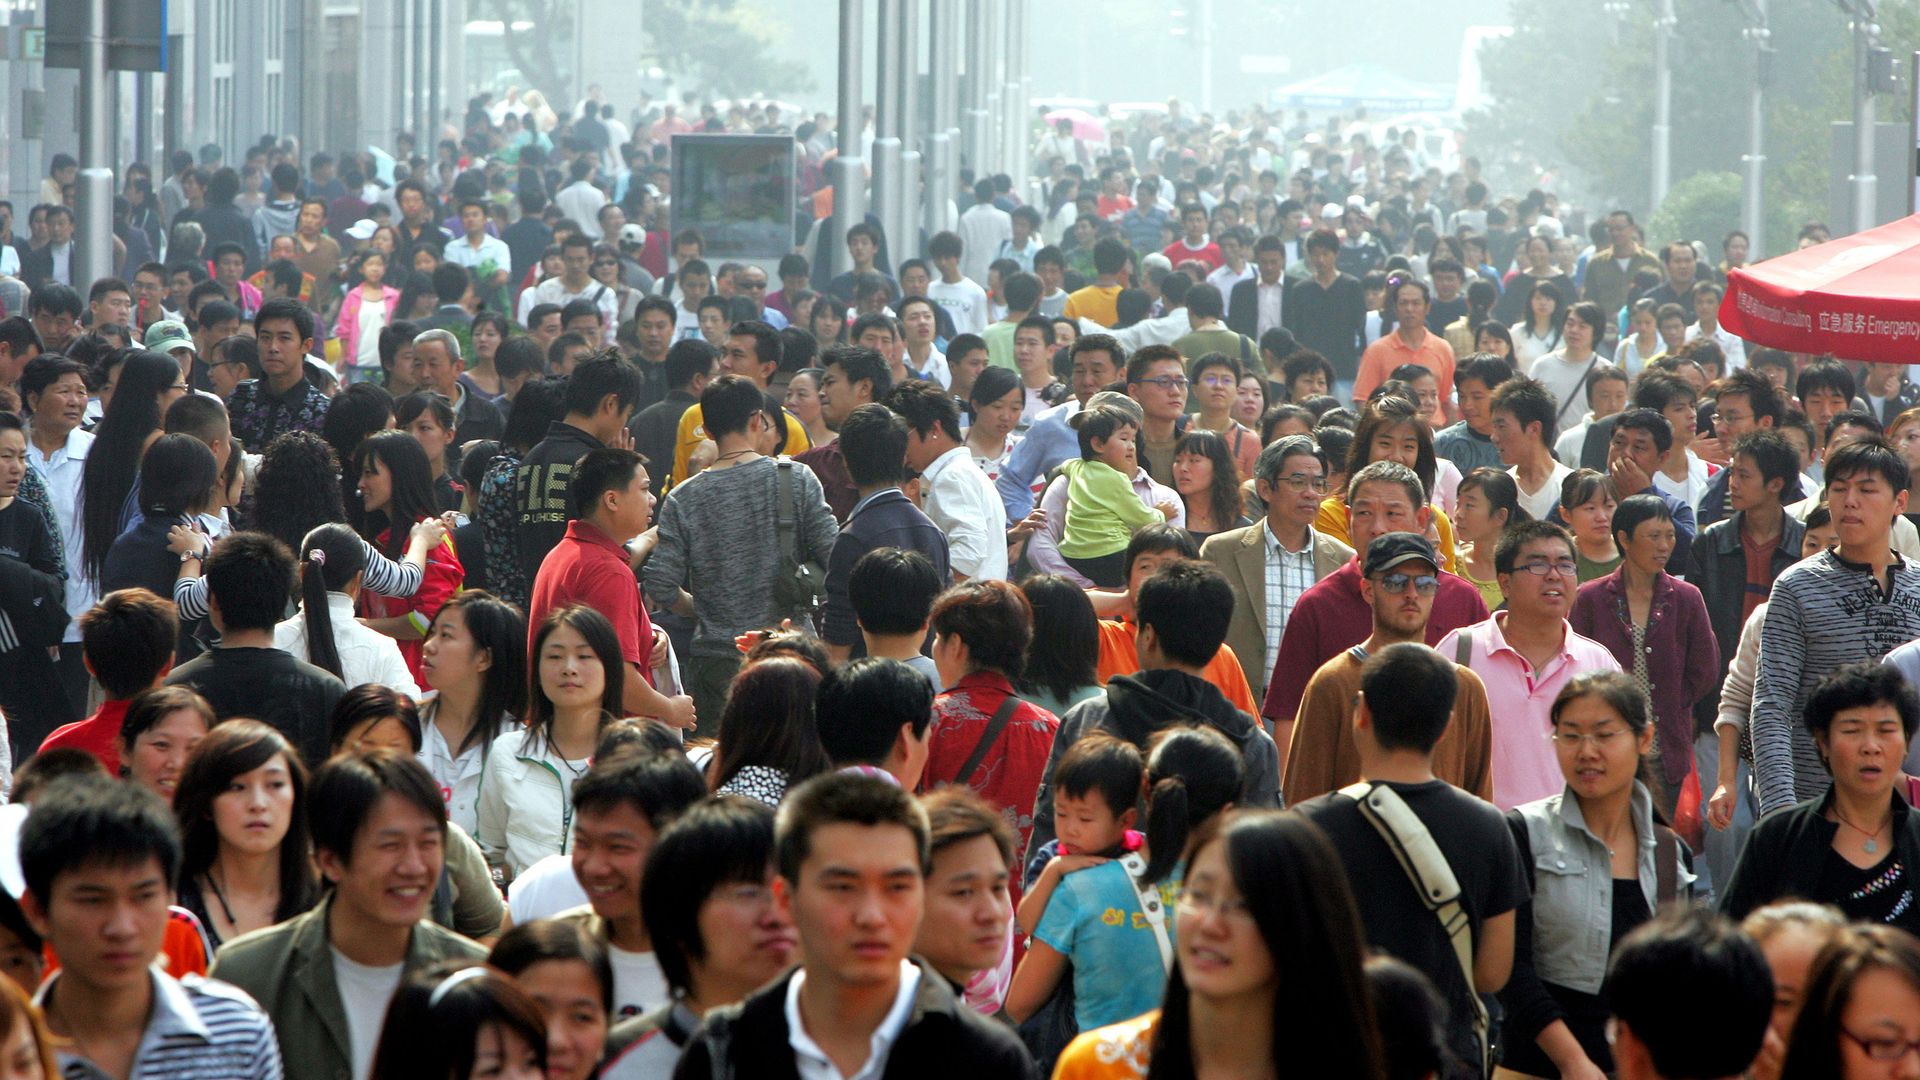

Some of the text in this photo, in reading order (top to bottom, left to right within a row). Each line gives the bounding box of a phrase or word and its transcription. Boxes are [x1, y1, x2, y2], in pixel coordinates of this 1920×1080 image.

[1819, 312, 1920, 340] 应急服务 Emergency
